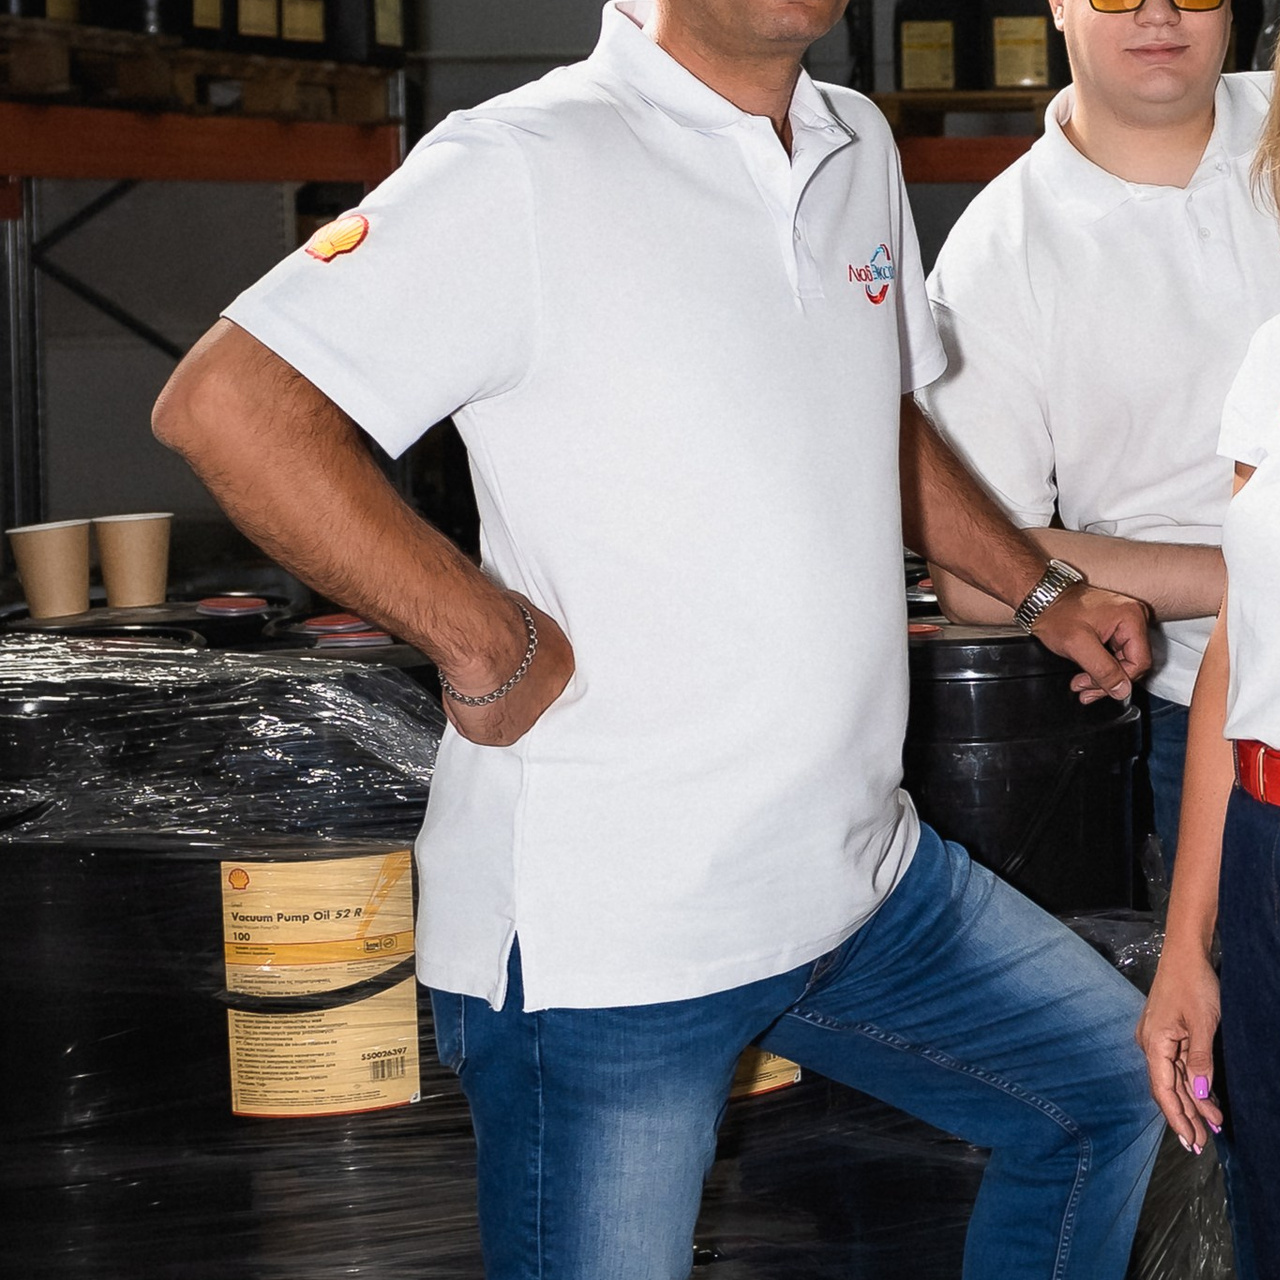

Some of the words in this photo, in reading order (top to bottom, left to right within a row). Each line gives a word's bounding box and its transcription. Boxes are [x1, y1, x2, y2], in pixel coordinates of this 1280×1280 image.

[231, 912, 273, 922] Vacuum
[277, 913, 310, 923] Pump
[313, 910, 330, 920] Oil
[335, 909, 351, 919] 52
[353, 908, 362, 917] R
[233, 932, 250, 941] 100
[361, 1047, 407, 1061] 550026397
